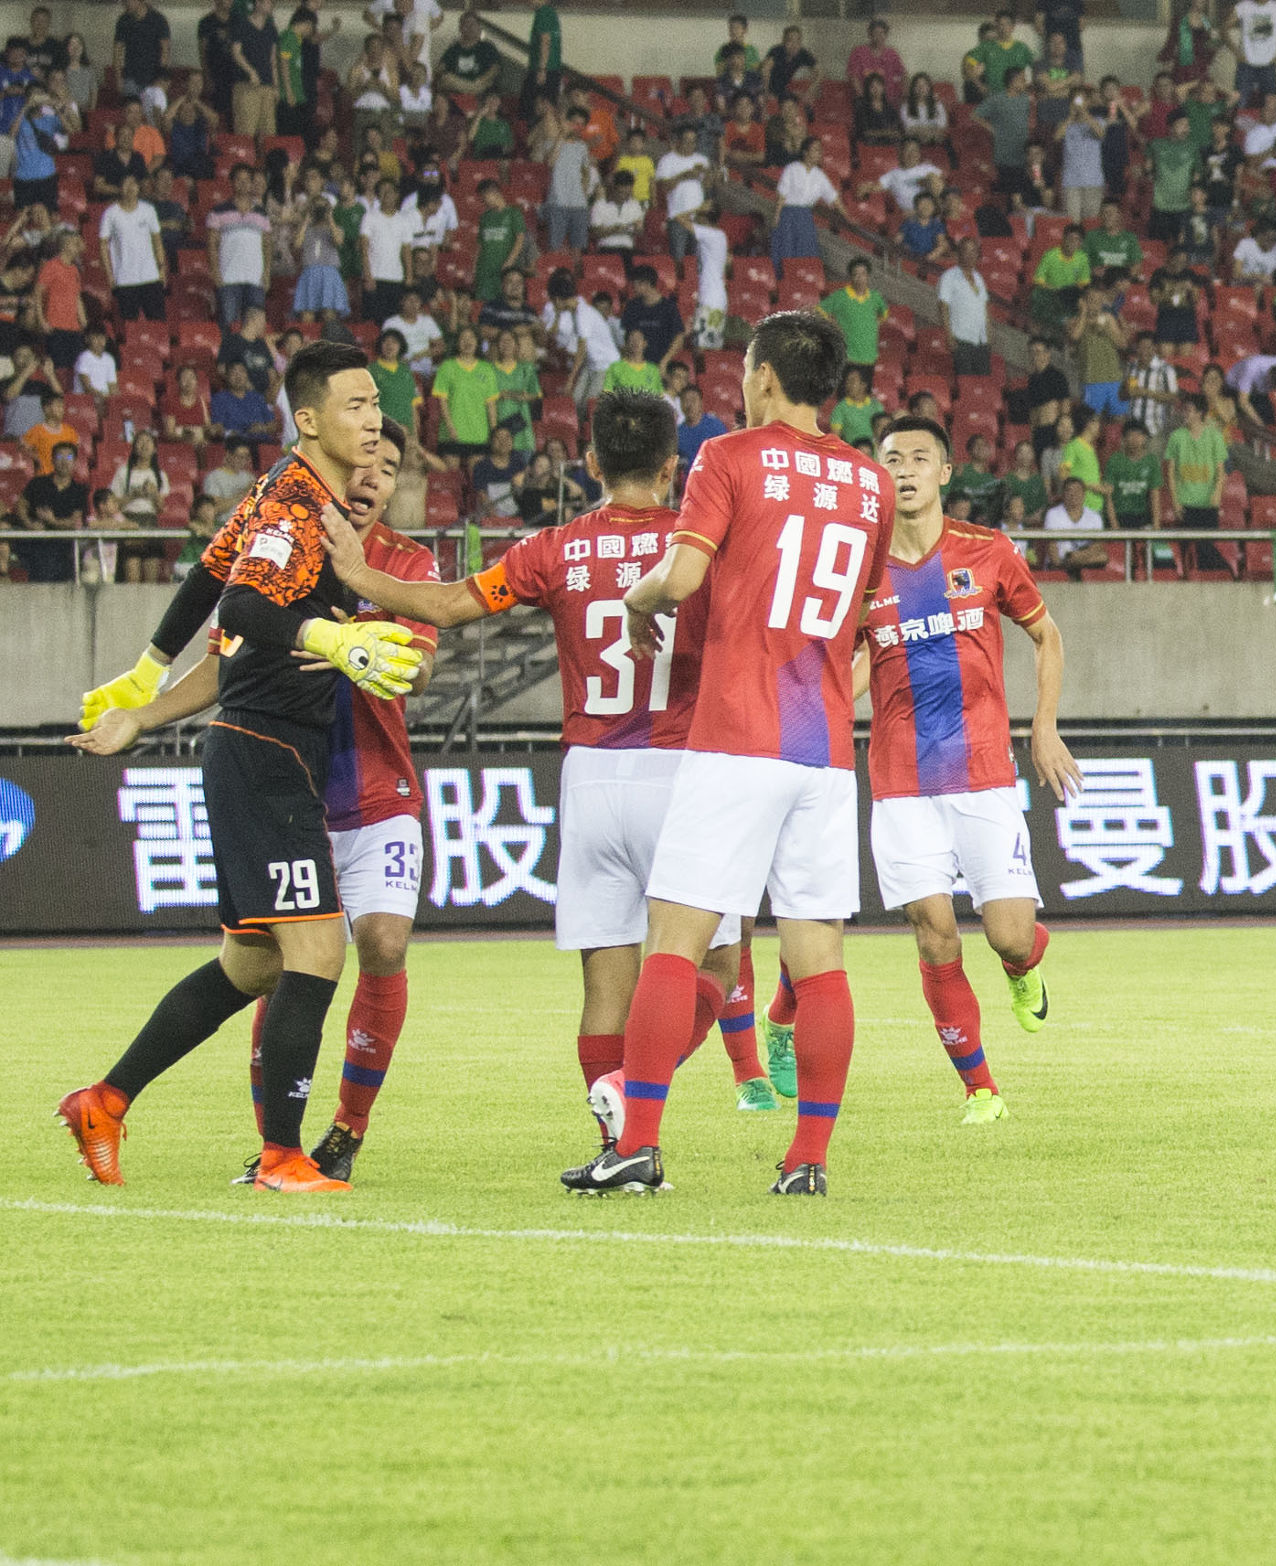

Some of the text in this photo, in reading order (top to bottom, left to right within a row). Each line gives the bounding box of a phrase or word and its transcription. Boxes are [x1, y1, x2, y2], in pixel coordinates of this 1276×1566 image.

[564, 531, 673, 562] 中國燃
[767, 514, 868, 640] 19
[874, 606, 985, 648] 燕京啤酒
[584, 599, 678, 715] 31
[1012, 832, 1027, 867] 4
[268, 858, 321, 911] 29
